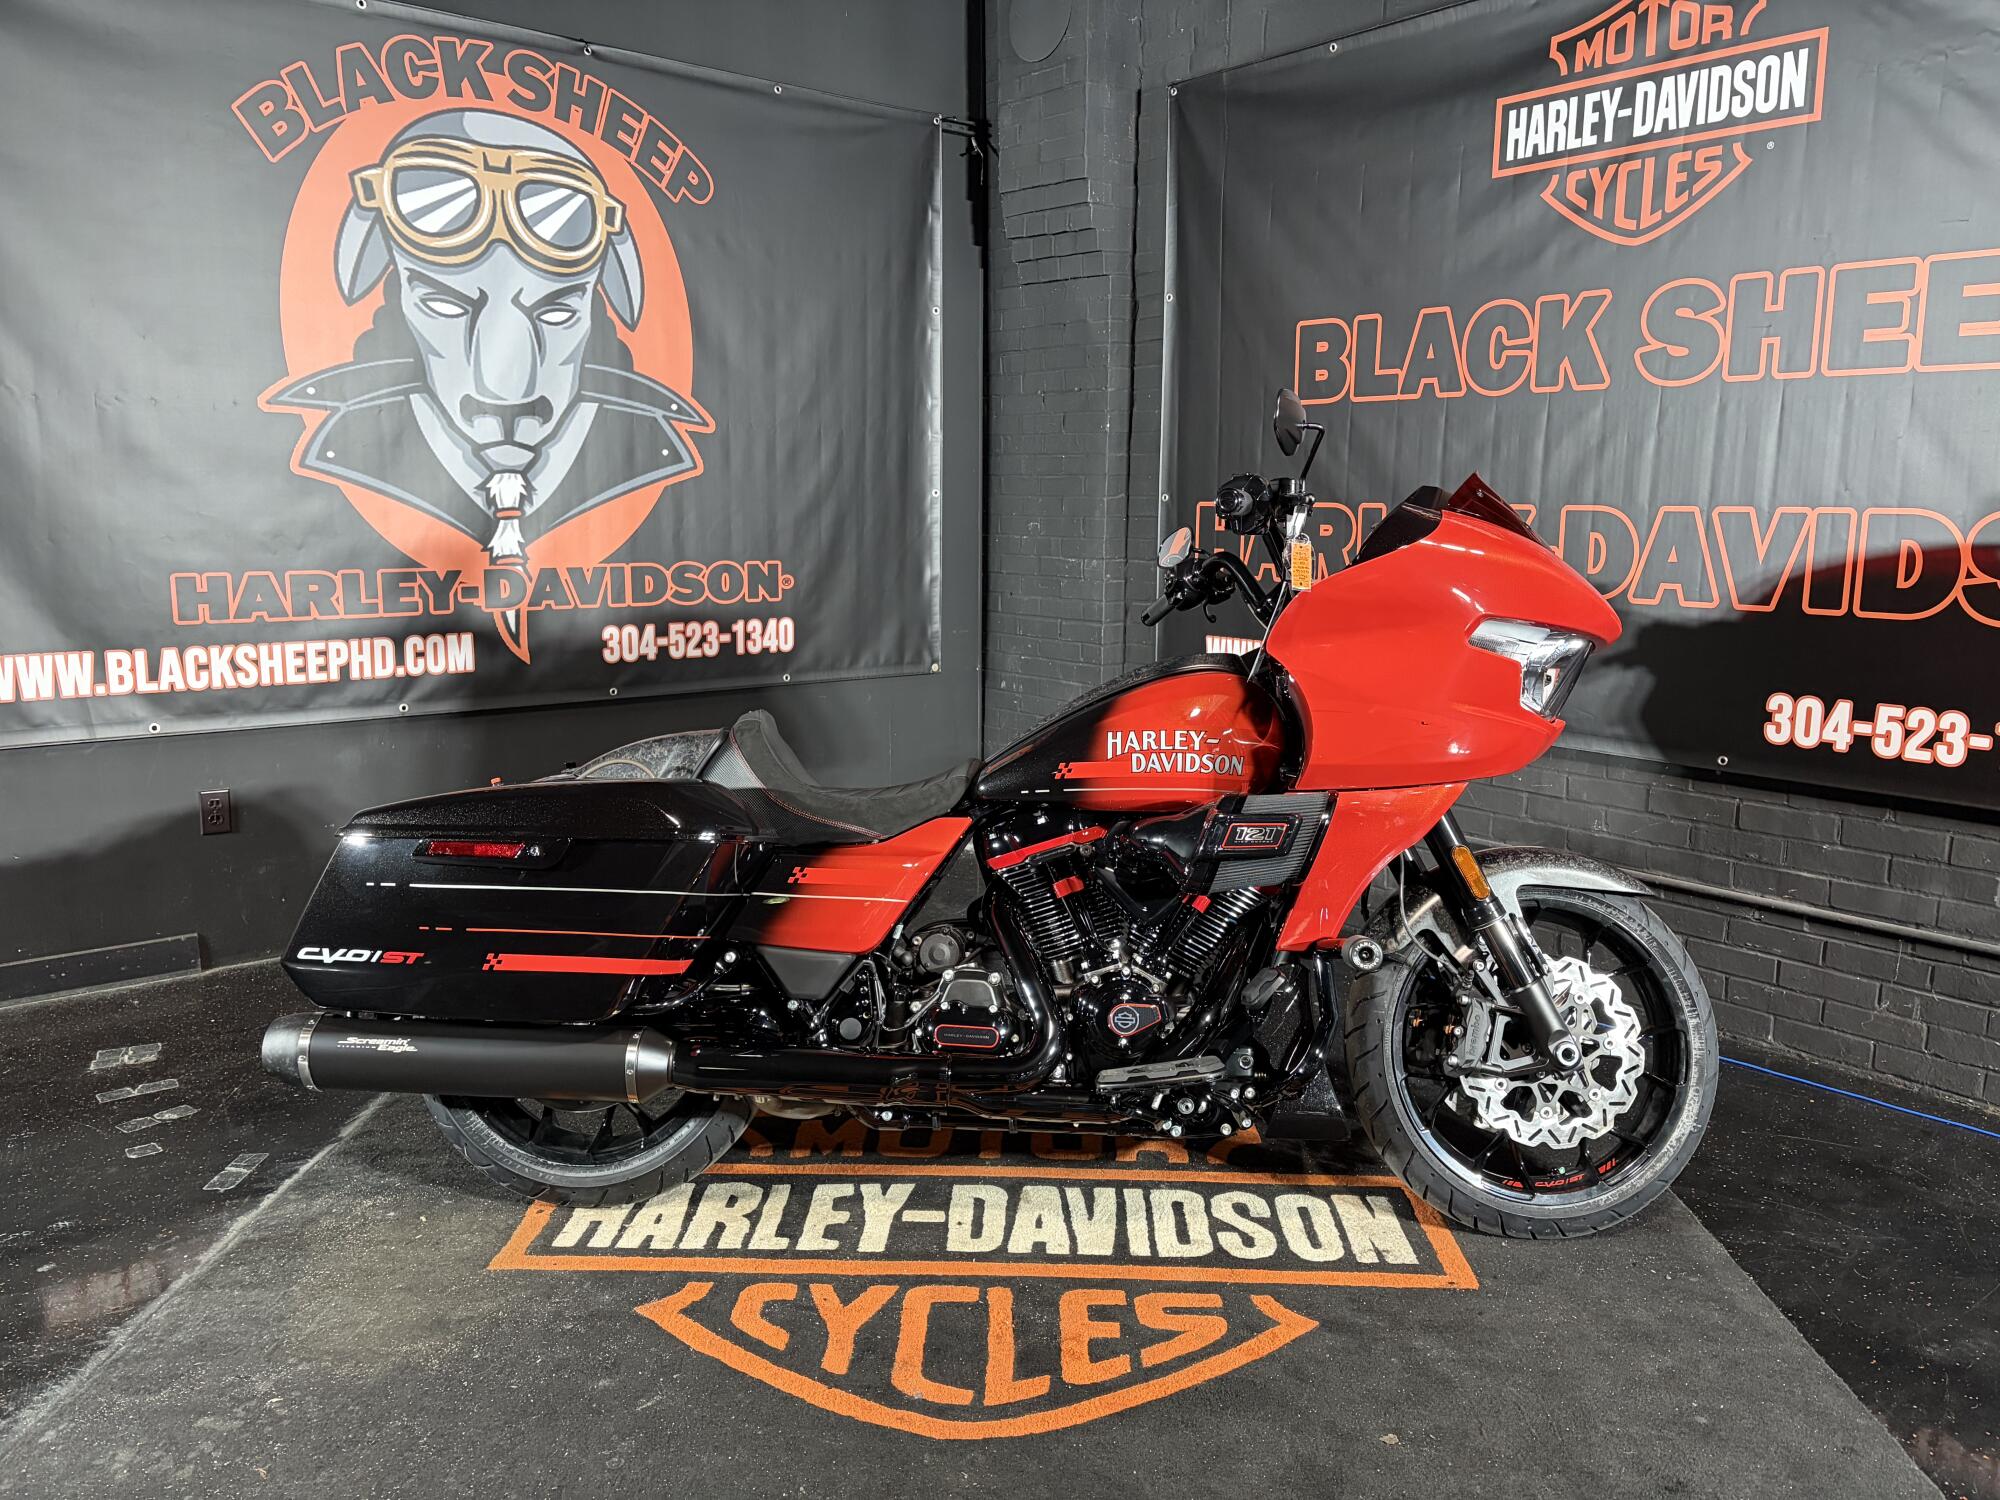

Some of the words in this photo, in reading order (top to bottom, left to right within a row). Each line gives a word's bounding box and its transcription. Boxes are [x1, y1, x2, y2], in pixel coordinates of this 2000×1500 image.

[1574, 0, 1734, 73] MOTOR
[232, 35, 495, 162] BLACK
[504, 49, 714, 204] SHEEP
[1506, 48, 1809, 161] HARLEY-DAVIDSON
[1565, 145, 1724, 230] CYCLES
[1294, 288, 1613, 405] BLACK
[1634, 248, 2000, 387] SHEE
[601, 616, 795, 664] 304-523-1340
[1131, 752, 1245, 776] DAVIDSON
[1764, 692, 2000, 767] 304-523-
[1235, 826, 1277, 841] 121
[377, 1044, 418, 1053] Eagle
[551, 1182, 1420, 1265] HARLEY-DAVIDSON
[730, 1282, 1228, 1406] CYCLES
